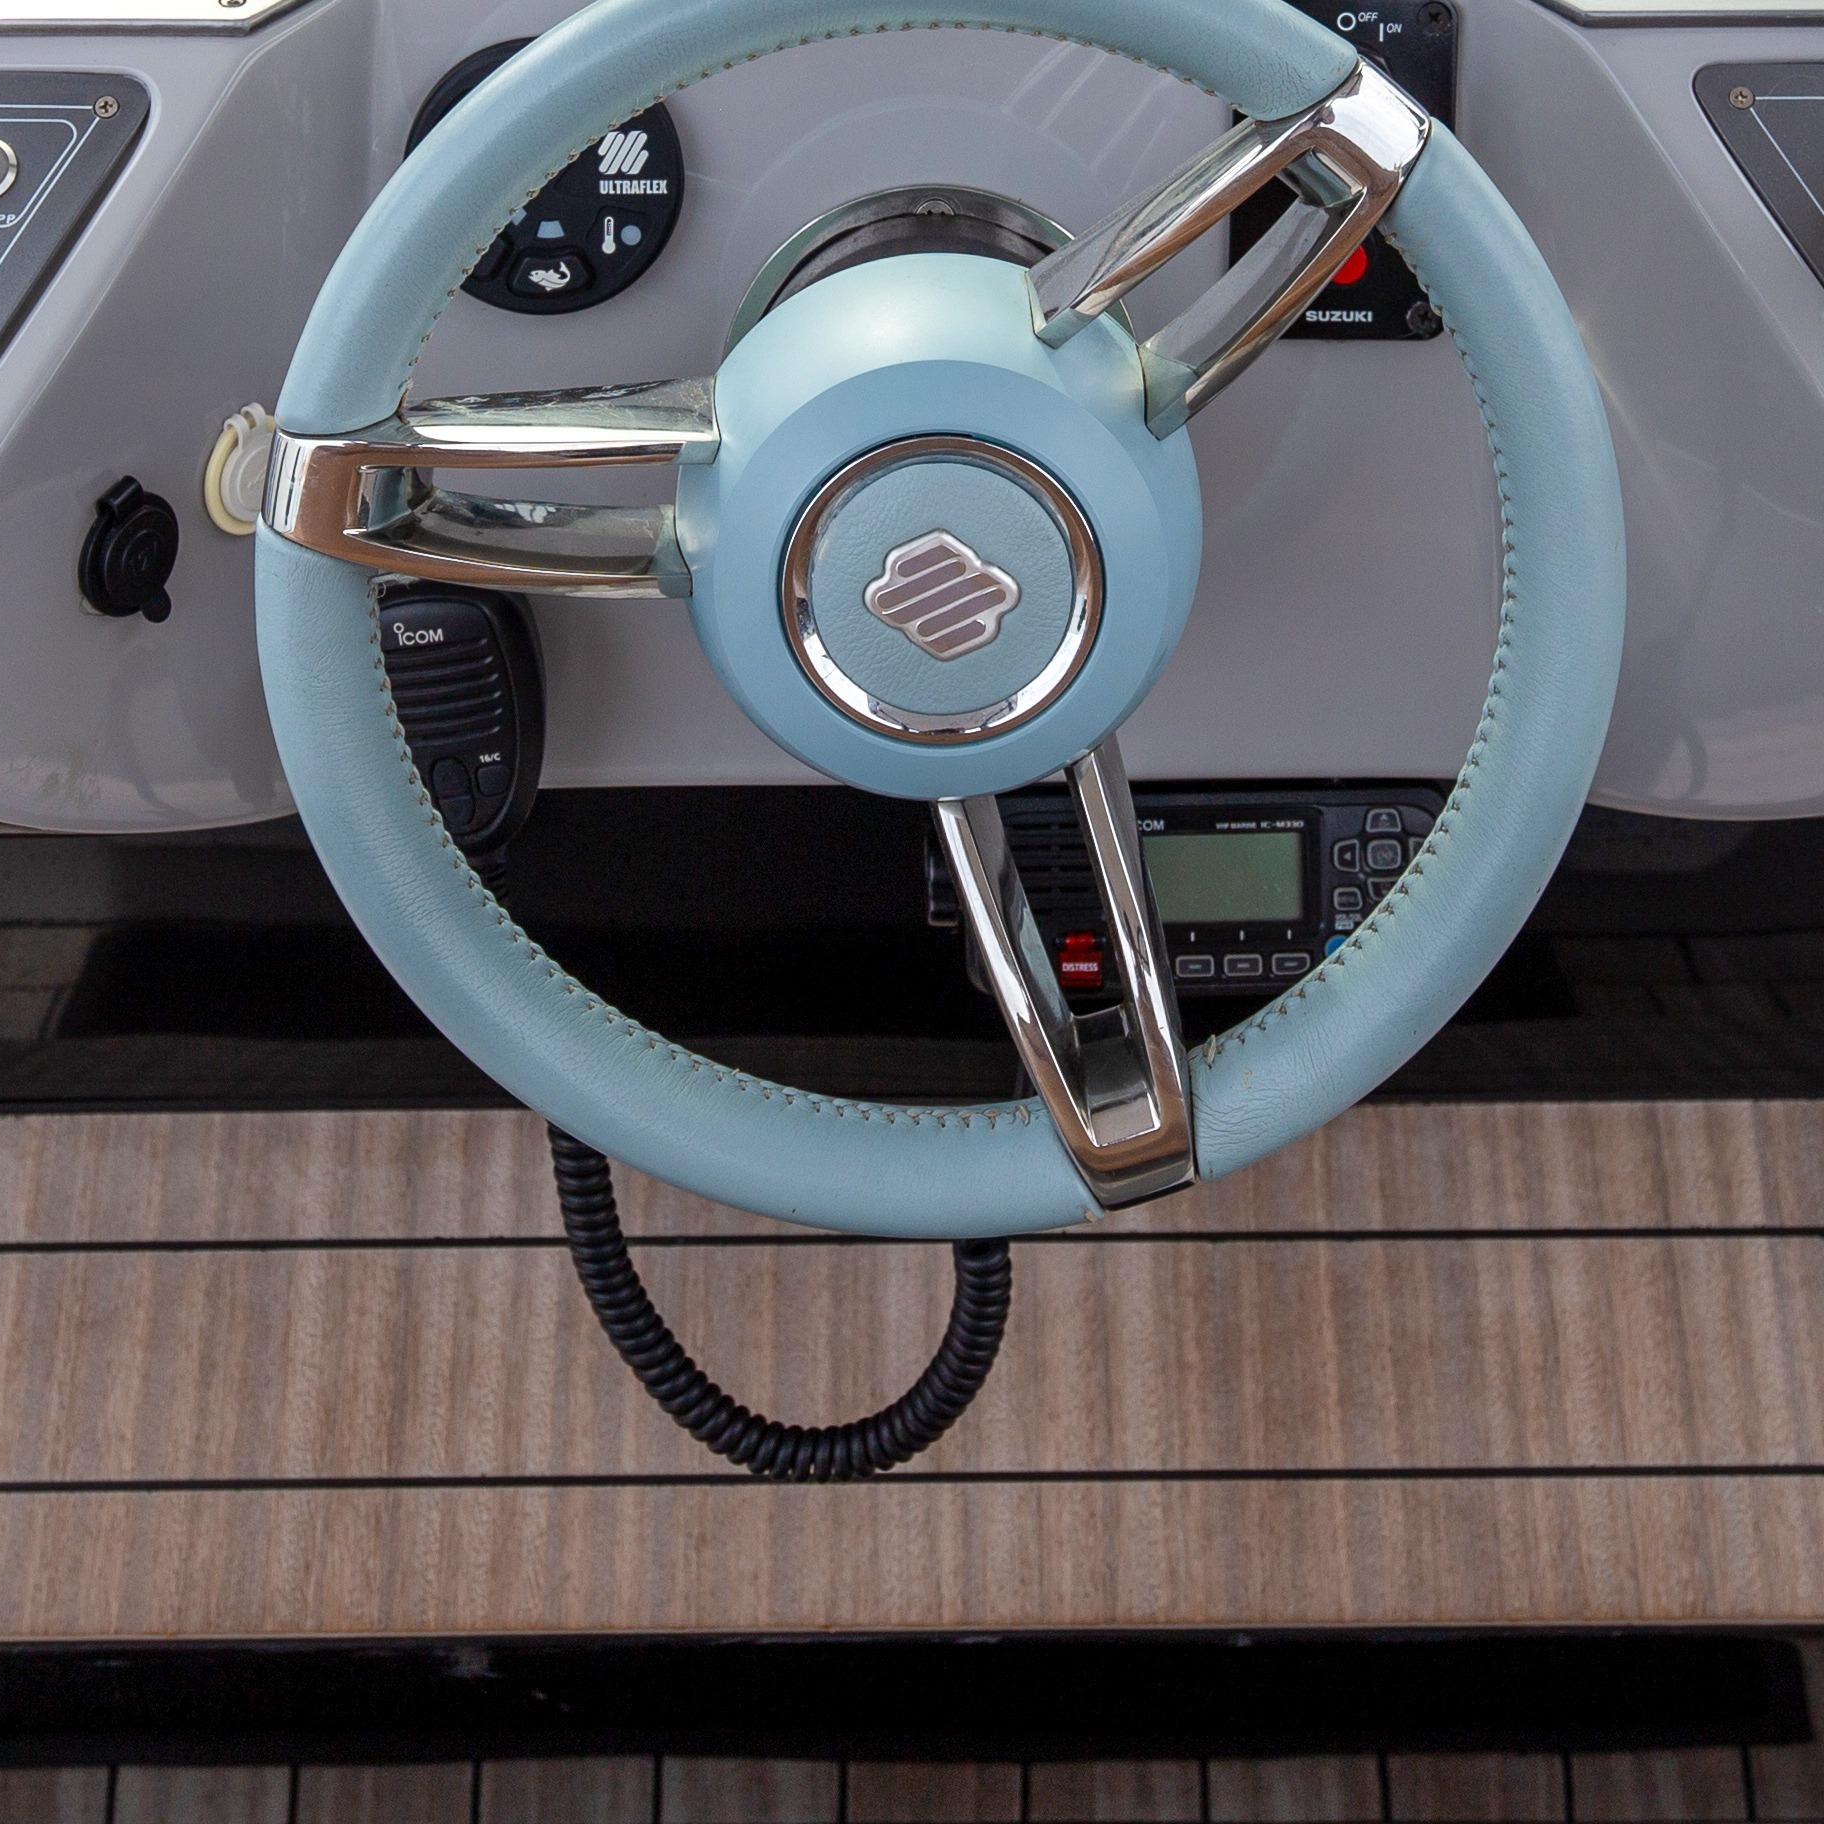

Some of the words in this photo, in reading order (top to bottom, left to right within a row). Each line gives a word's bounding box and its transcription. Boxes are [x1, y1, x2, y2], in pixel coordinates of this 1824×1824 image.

[1358, 12, 1378, 23] OFF
[1386, 23, 1403, 33] ON
[599, 179, 668, 195] ULTRAFLEX
[1305, 310, 1373, 323] SUZUKI
[479, 752, 502, 764] 16/C
[1062, 961, 1099, 973] DISTRESS
